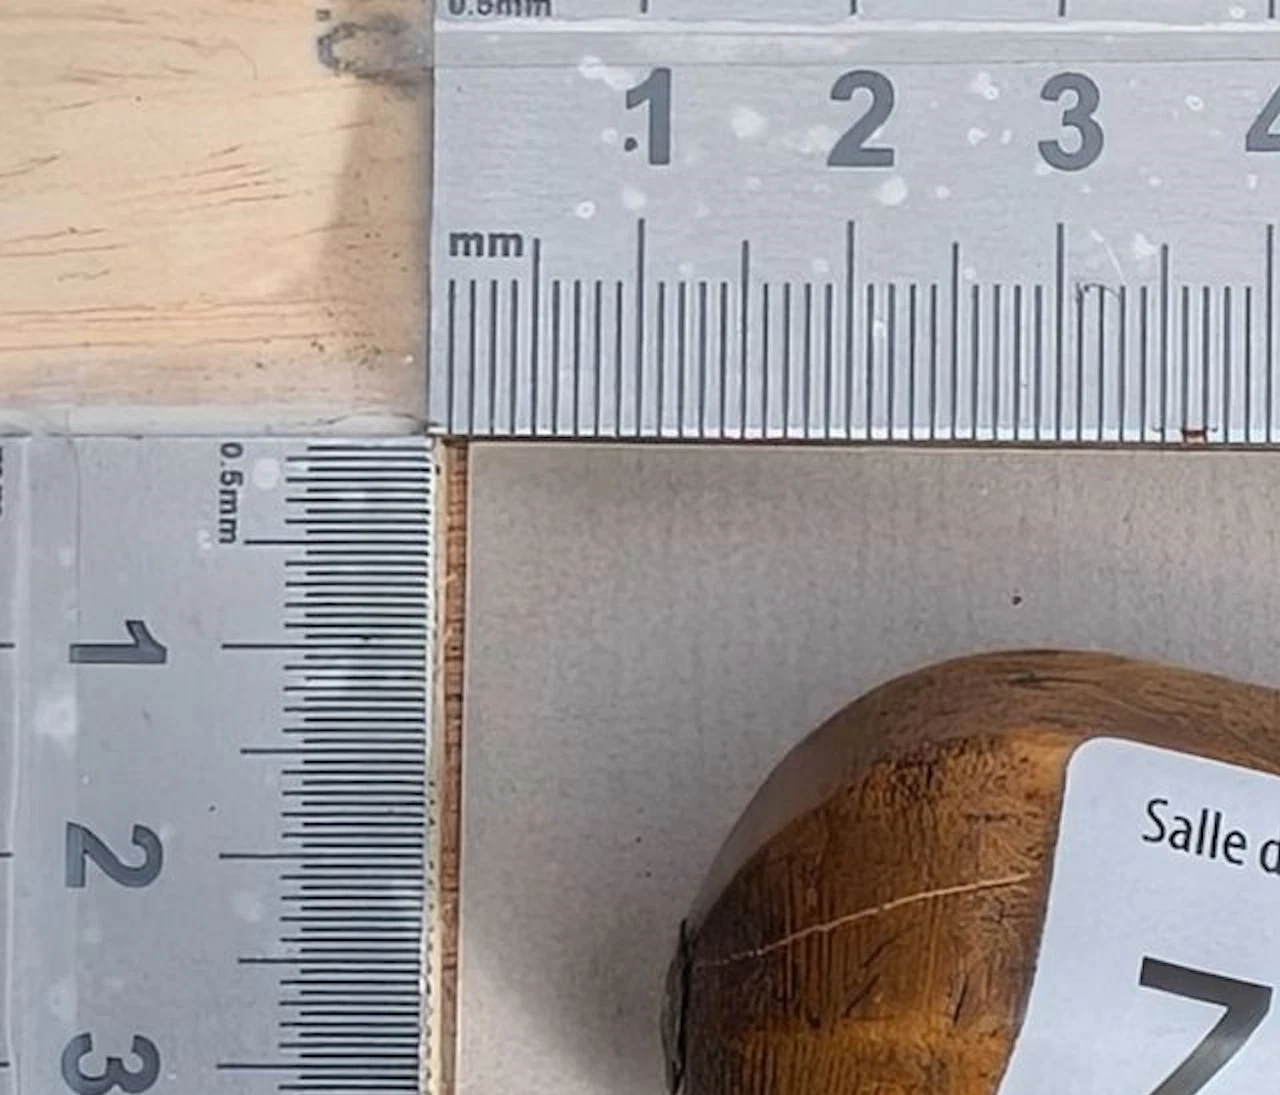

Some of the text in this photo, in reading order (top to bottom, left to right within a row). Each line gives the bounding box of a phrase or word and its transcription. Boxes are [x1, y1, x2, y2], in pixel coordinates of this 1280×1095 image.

[626, 67, 671, 165] 1
[827, 70, 894, 167] 2
[1038, 72, 1104, 171] 3
[448, 231, 524, 258] mm
[218, 442, 244, 544] 0.5mm
[69, 620, 168, 664] 1
[65, 822, 164, 888] 2
[1142, 798, 1247, 866] Salle
